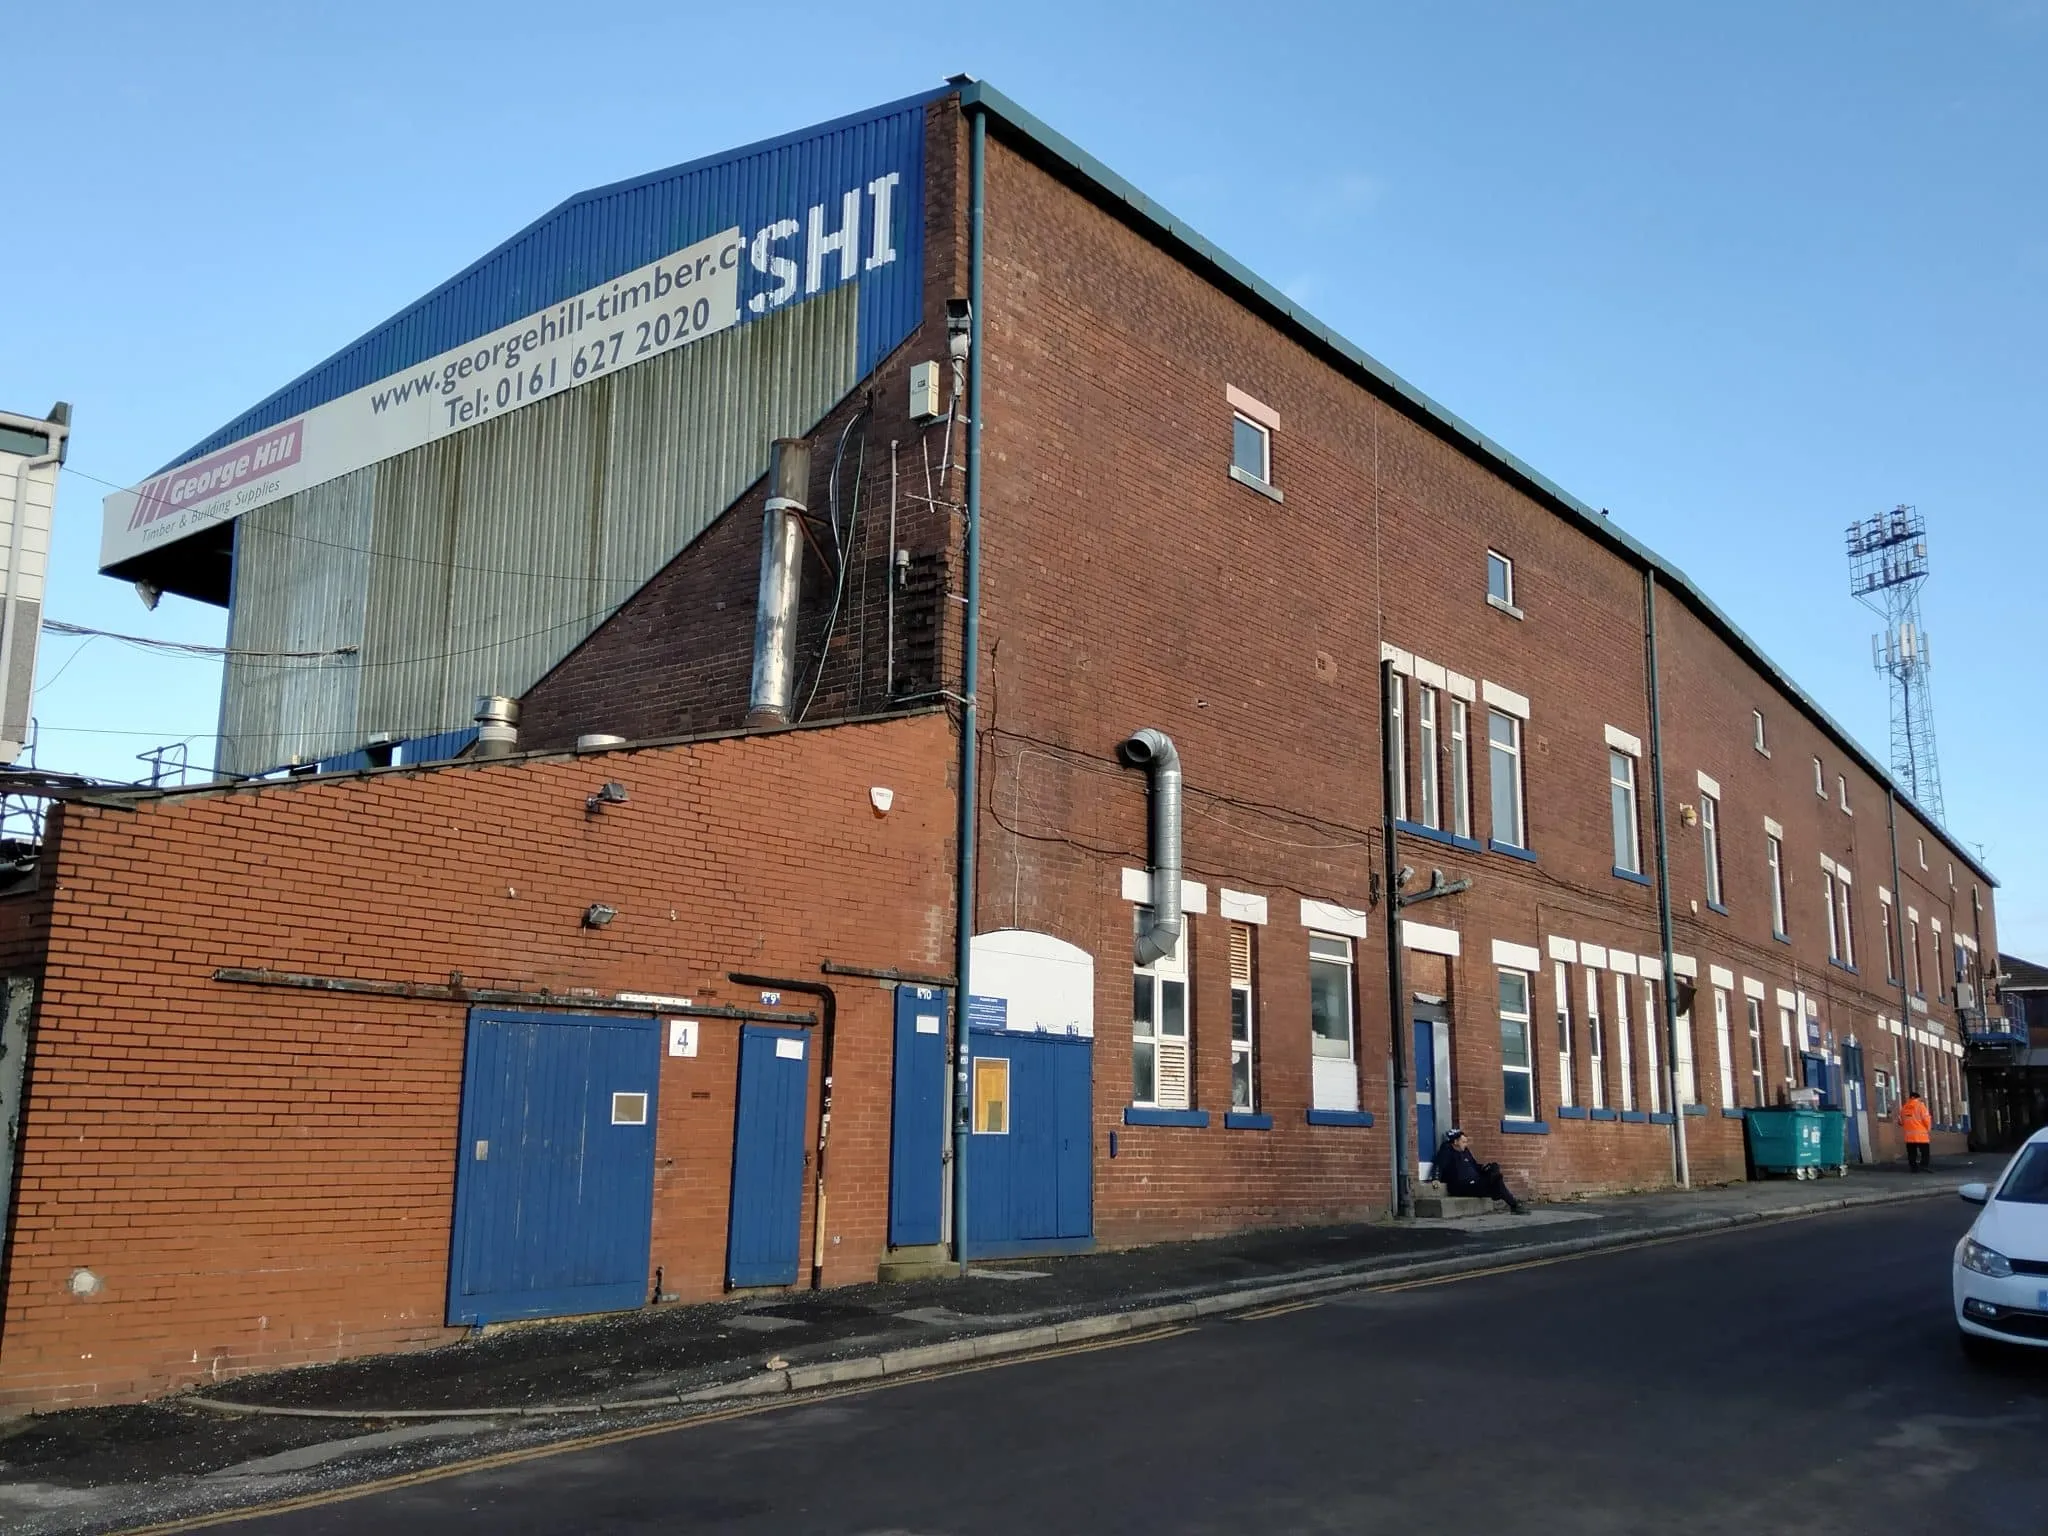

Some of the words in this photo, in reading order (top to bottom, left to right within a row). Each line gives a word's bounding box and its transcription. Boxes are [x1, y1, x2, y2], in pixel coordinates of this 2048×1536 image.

[736, 172, 899, 320] SHI
[371, 244, 736, 415] www.georgehill-timber.c
[444, 392, 489, 427] Tel:
[496, 358, 557, 409] 0161
[572, 331, 625, 379] 627
[635, 297, 710, 355] 2020
[142, 522, 176, 543] Timber
[179, 514, 187, 529] &
[191, 498, 232, 524] Building
[235, 480, 280, 506] Supplies
[170, 455, 250, 505] George
[253, 432, 295, 471] Hill
[677, 1028, 689, 1046] 4
